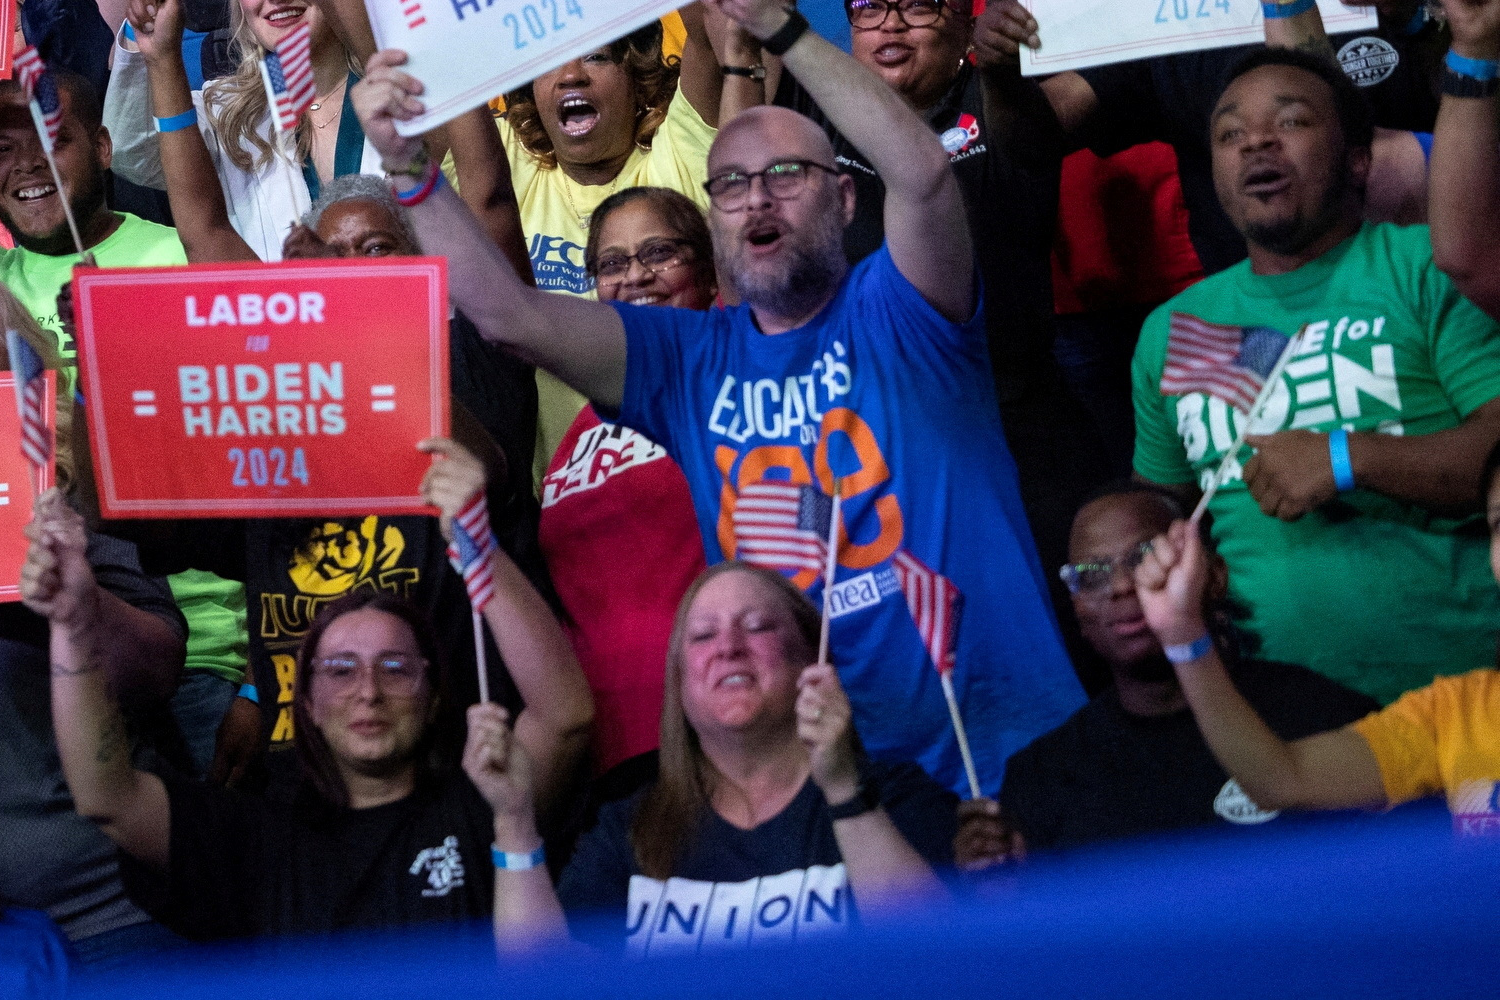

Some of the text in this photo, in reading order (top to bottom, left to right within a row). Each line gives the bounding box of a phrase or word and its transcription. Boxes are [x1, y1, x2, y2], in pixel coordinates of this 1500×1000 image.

[537, 261, 558, 272] for
[185, 291, 326, 327] LABOR
[1332, 315, 1386, 350] for
[178, 361, 344, 404] BIDEN
[182, 403, 347, 437] HARRIS
[227, 446, 310, 487] 2024
[830, 579, 876, 613] nea
